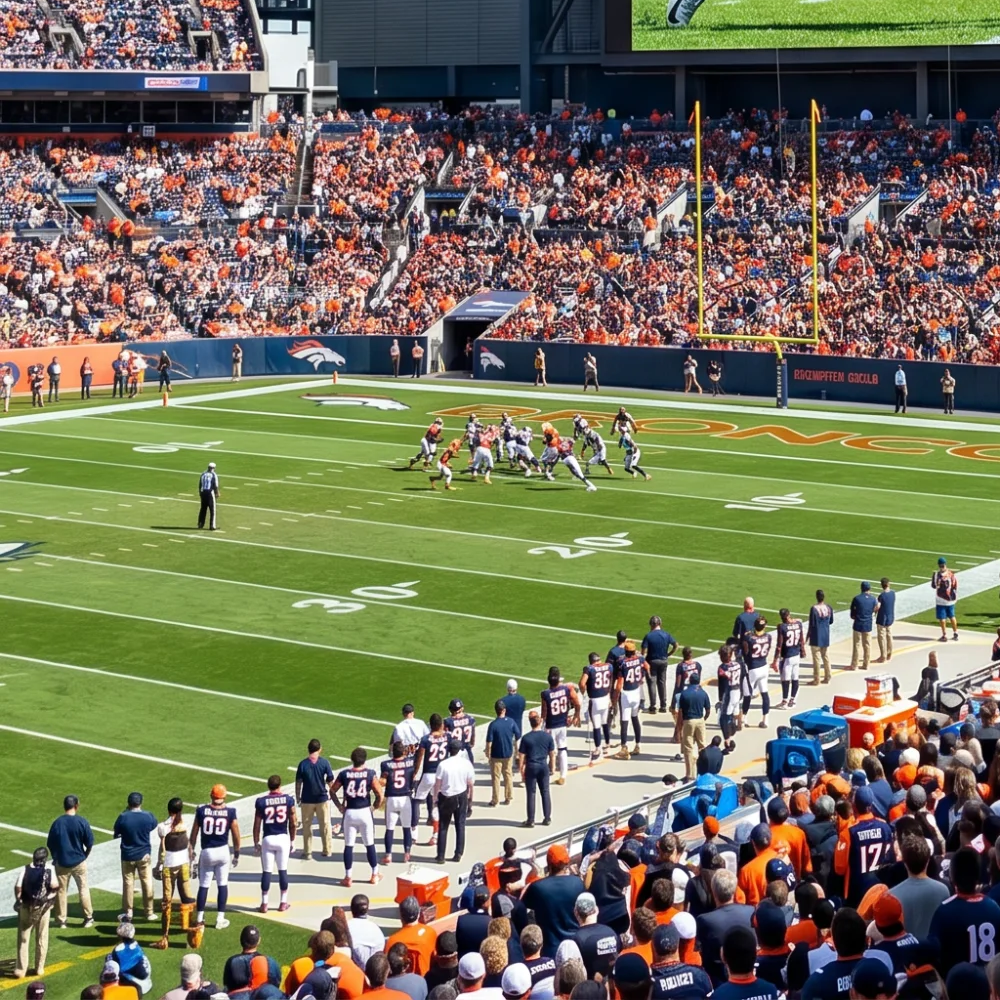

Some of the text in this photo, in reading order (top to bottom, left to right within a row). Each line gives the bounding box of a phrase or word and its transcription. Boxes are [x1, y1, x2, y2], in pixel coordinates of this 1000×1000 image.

[724, 495, 806, 512] 10
[527, 536, 633, 559] 20
[292, 586, 419, 613] 30
[594, 671, 610, 689] 36
[626, 665, 642, 683] 49
[394, 770, 405, 789] 5
[347, 780, 368, 798] 44
[265, 806, 287, 824] 23
[967, 922, 996, 963] 18
